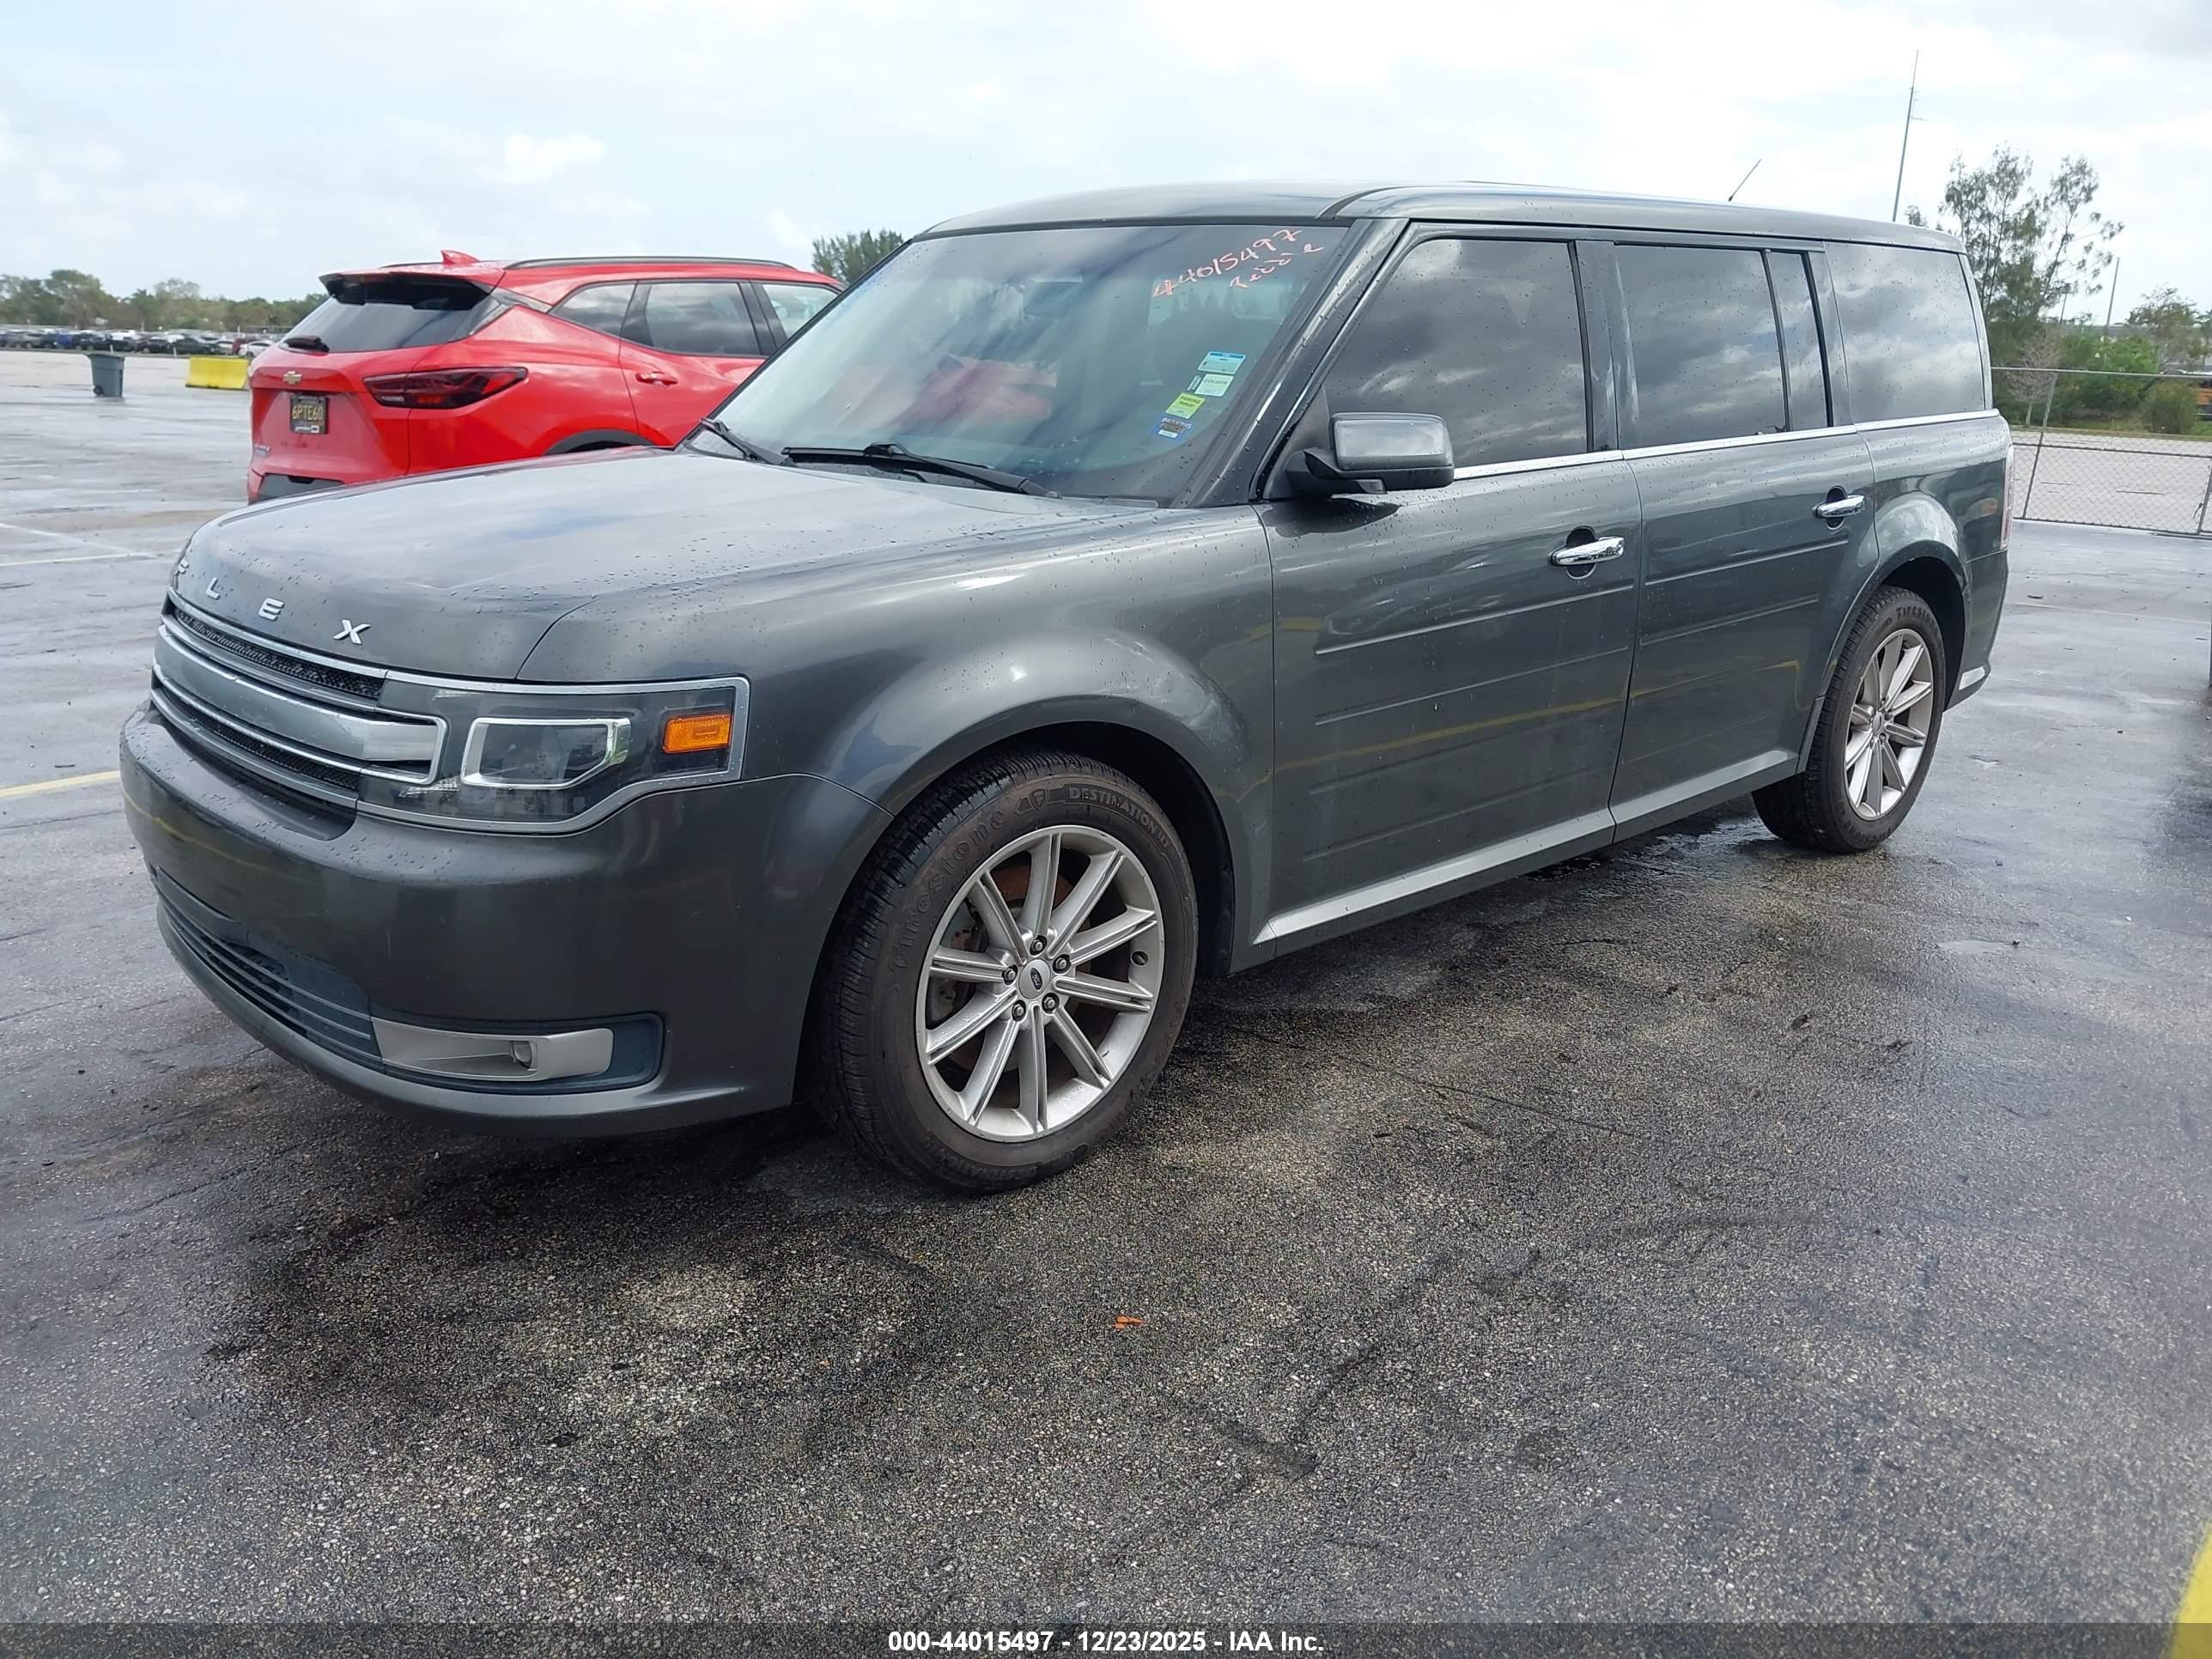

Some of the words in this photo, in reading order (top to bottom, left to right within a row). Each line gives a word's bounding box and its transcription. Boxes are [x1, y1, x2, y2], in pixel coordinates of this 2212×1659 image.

[1153, 228, 1302, 297] 44015497
[174, 559, 371, 645] FLEX
[1068, 787, 1158, 836] DESTINATION
